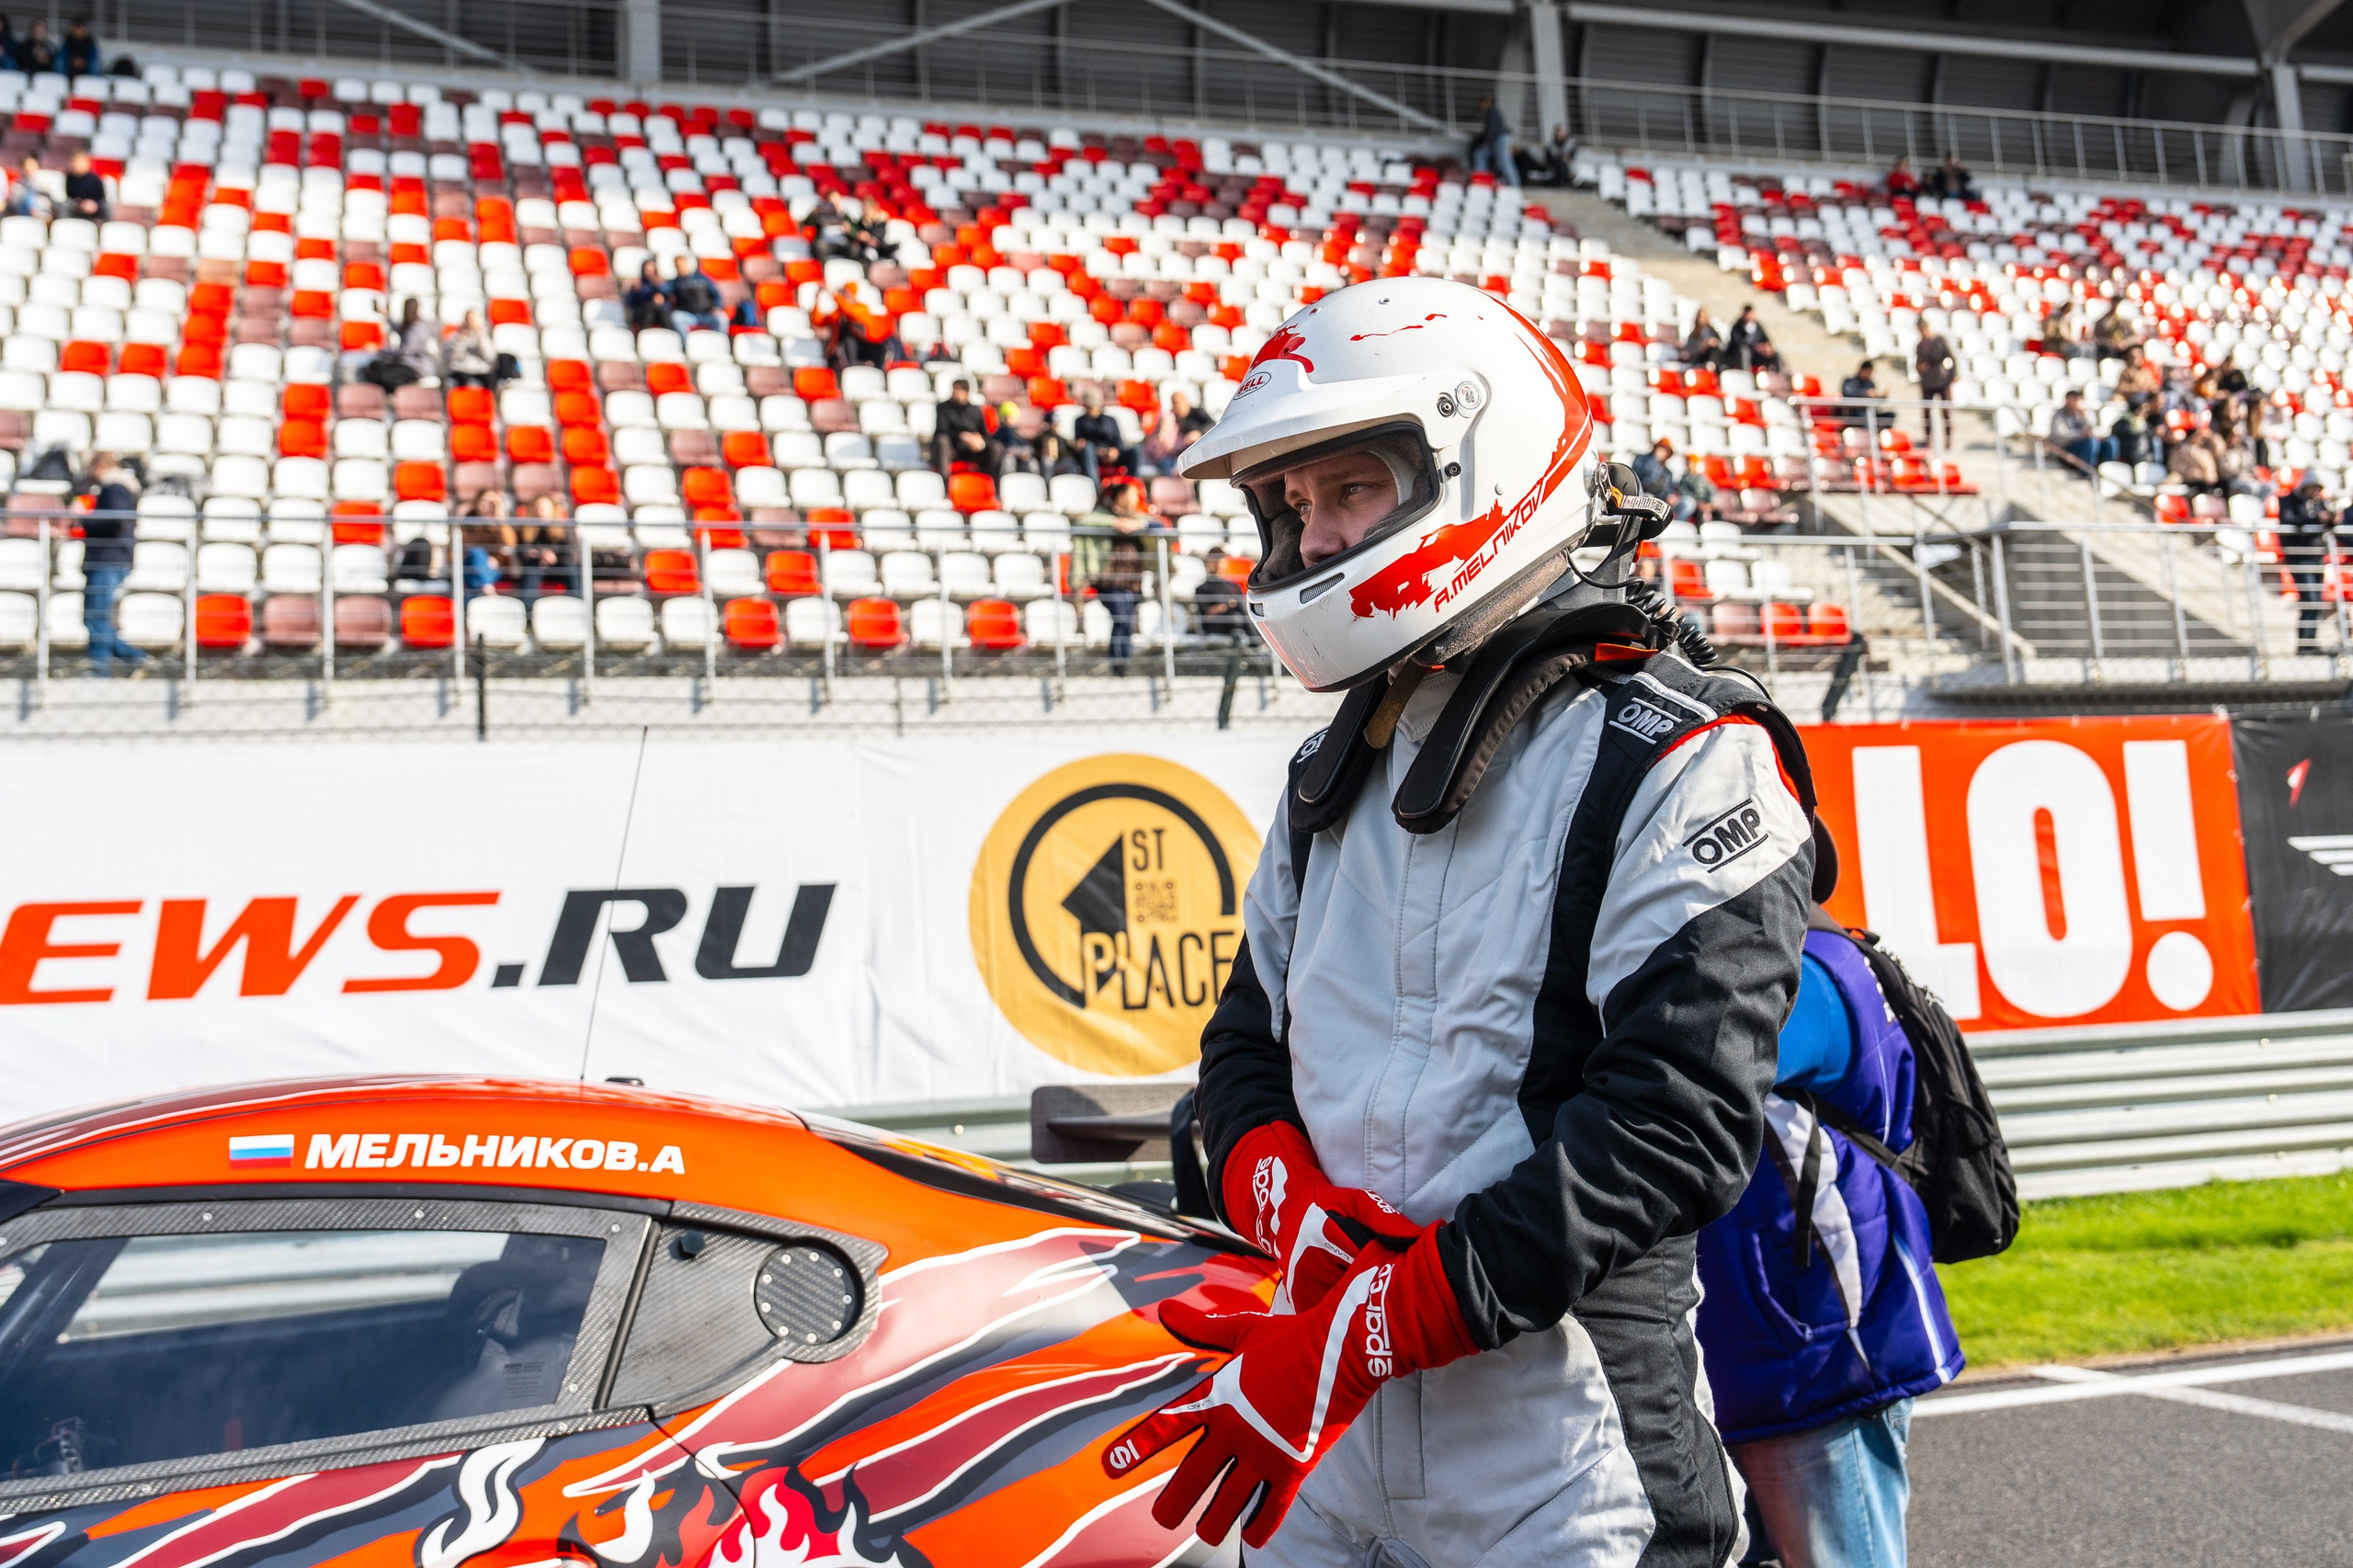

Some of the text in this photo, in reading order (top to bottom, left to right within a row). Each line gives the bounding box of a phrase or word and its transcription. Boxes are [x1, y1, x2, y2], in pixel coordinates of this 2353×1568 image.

[1237, 375, 1264, 395] BELL
[1618, 703, 1674, 736] OMP
[1692, 808, 1761, 865] OMP
[1851, 739, 2214, 1020] LO!
[0, 881, 838, 1005] EWS.RU
[1082, 931, 1234, 1011] PLACE
[304, 1133, 686, 1175] МЕЛЬНИКОВ.А
[1364, 1189, 1400, 1214] spar
[1365, 1264, 1393, 1377] sparco
